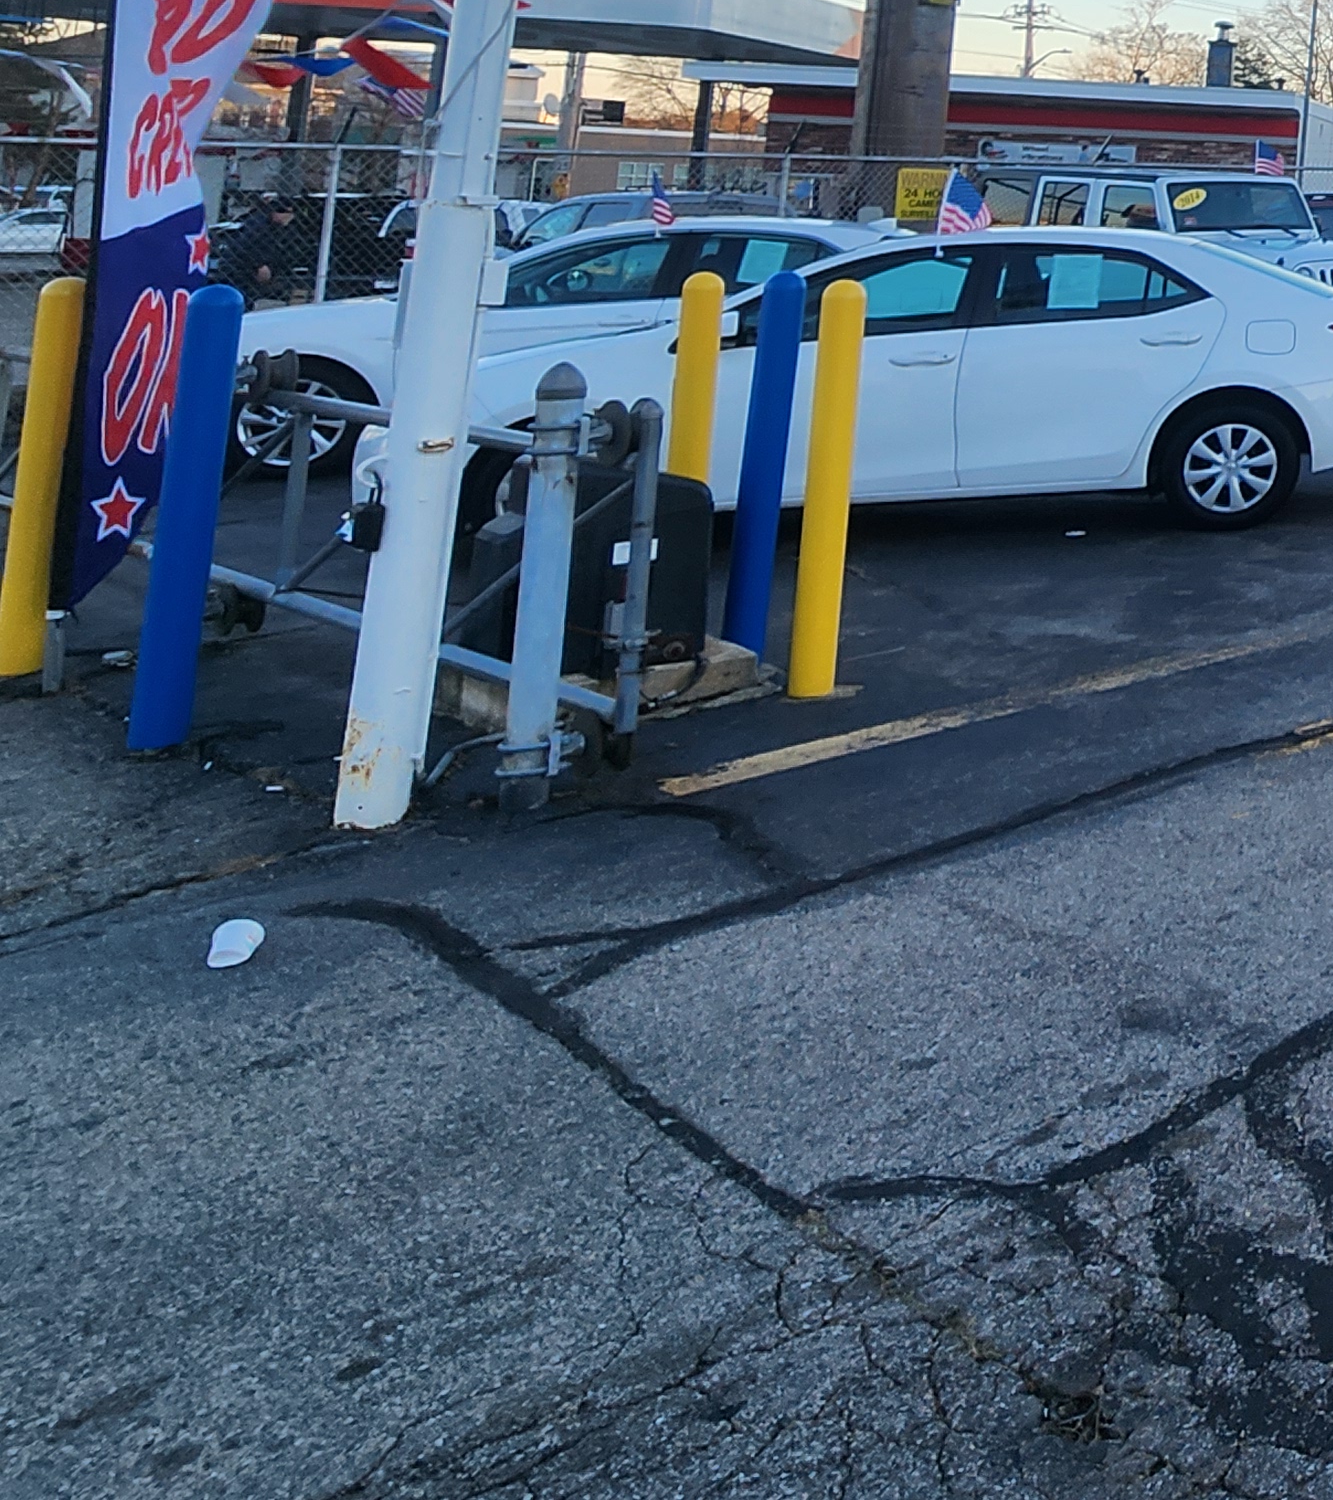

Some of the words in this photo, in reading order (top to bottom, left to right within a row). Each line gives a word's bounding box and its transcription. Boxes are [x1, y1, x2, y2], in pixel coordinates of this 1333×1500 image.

[901, 171, 947, 188] WARNIN
[904, 188, 918, 198] 24
[923, 188, 942, 198] HO
[908, 199, 938, 208] CAME
